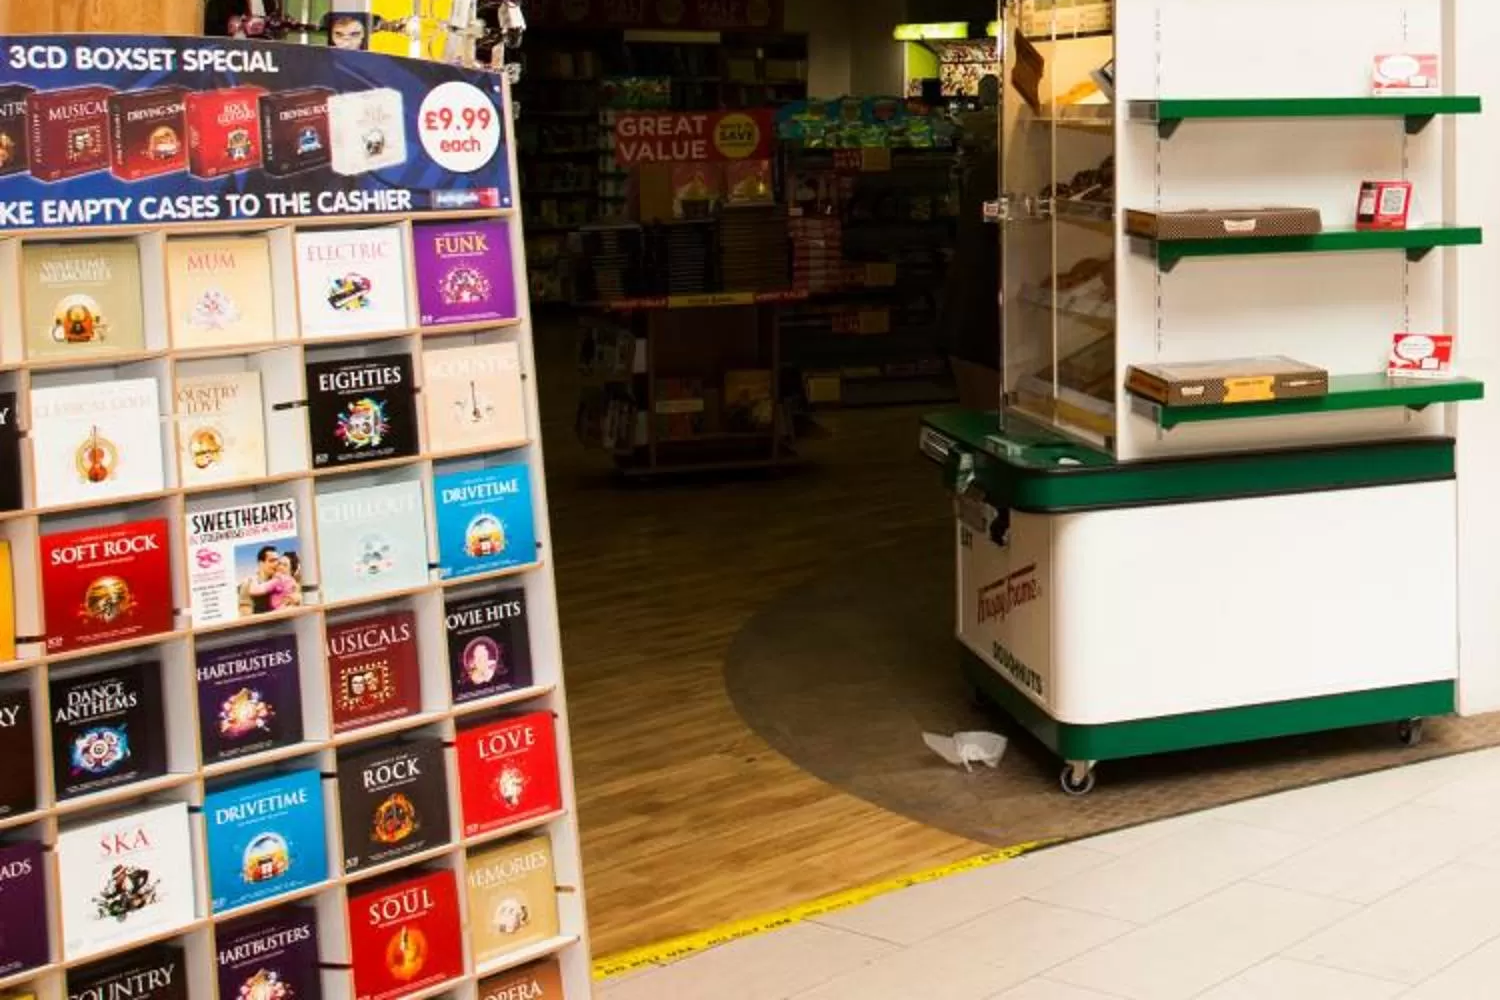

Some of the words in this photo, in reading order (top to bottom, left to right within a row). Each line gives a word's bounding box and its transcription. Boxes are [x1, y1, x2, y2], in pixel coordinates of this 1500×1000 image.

[9, 45, 68, 70] 3CD
[75, 46, 177, 71] BOXSET
[183, 49, 279, 73] SPECIAL
[48, 100, 109, 121] MUSICAL
[424, 107, 492, 131] £9.99
[618, 115, 708, 137] GREAT
[439, 137, 481, 153] each
[619, 139, 709, 162] VALUE
[0, 201, 35, 226] KE
[42, 197, 134, 224] EMPTY
[139, 194, 220, 220] CASES
[225, 193, 261, 217] TO
[266, 191, 312, 216] THE
[317, 189, 413, 213] CASHIER
[306, 242, 391, 262] ELECTRIC
[434, 234, 489, 256] FUNK
[187, 253, 237, 272] MUM
[319, 366, 402, 392] EIGHTIES
[442, 479, 520, 504] DRIVETIME
[191, 501, 294, 535] SWEETHEARTS
[50, 542, 99, 568] SOFT
[103, 533, 160, 558] ROCK
[445, 606, 483, 630] OVIE
[486, 601, 522, 624] HITS
[197, 650, 293, 682] HARTBUSTERS
[55, 691, 138, 723] ANTHEMS
[67, 683, 125, 708] DANCE
[478, 727, 536, 760] LOVE
[362, 757, 422, 789] ROCK
[215, 786, 308, 825] DRIVETIME
[100, 828, 151, 856] SKA
[369, 887, 434, 926] SOUL
[69, 963, 175, 1000] OUNTRY
